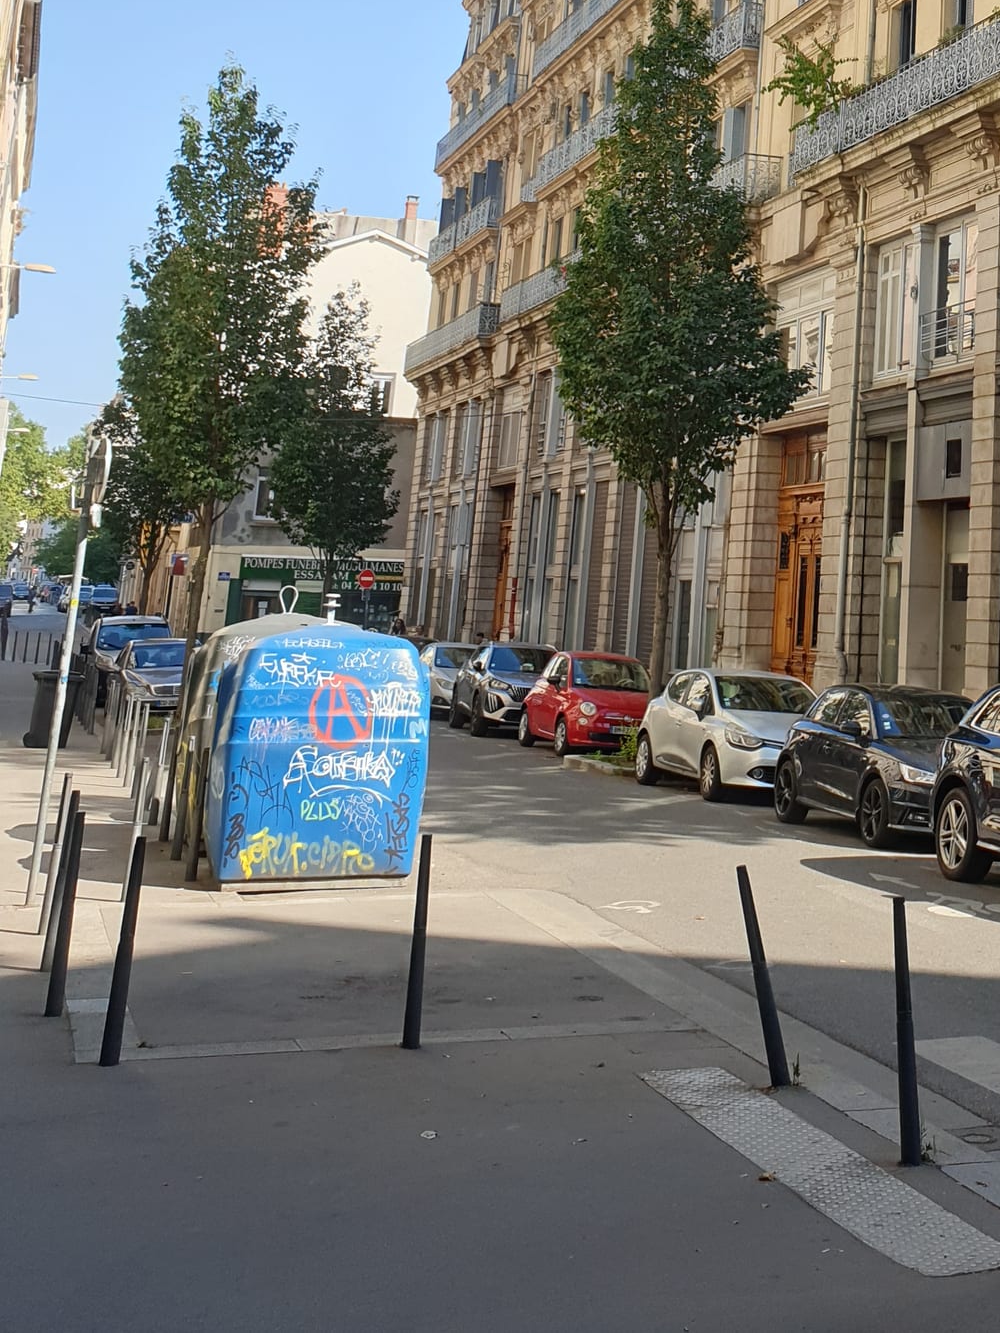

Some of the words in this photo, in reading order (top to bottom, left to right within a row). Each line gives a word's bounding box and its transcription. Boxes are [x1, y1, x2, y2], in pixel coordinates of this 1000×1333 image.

[244, 557, 284, 569] POMPES
[294, 570, 350, 581] ESSAAM
[380, 583, 390, 591] 10
